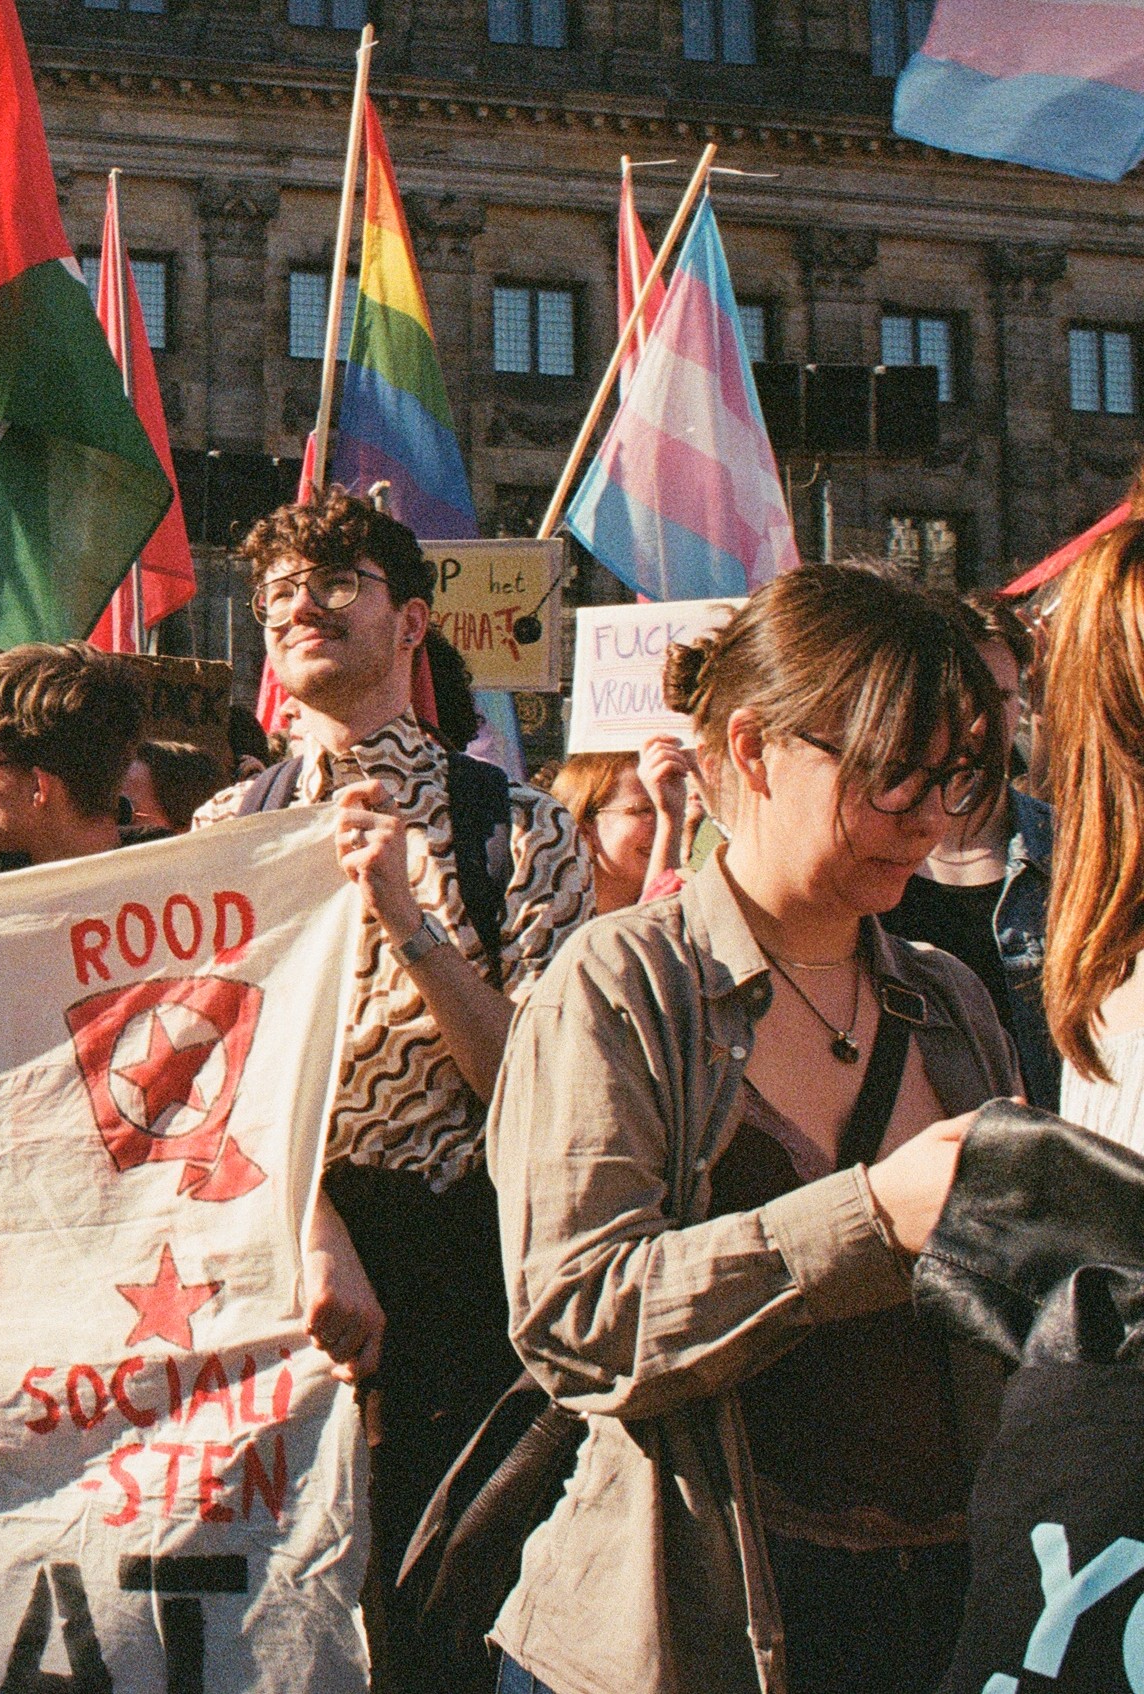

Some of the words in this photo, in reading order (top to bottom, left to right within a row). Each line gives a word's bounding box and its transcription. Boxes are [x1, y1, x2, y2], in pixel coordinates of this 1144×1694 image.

[488, 560, 526, 594] het
[593, 622, 686, 661] FUCK
[70, 889, 258, 985] ROOD
